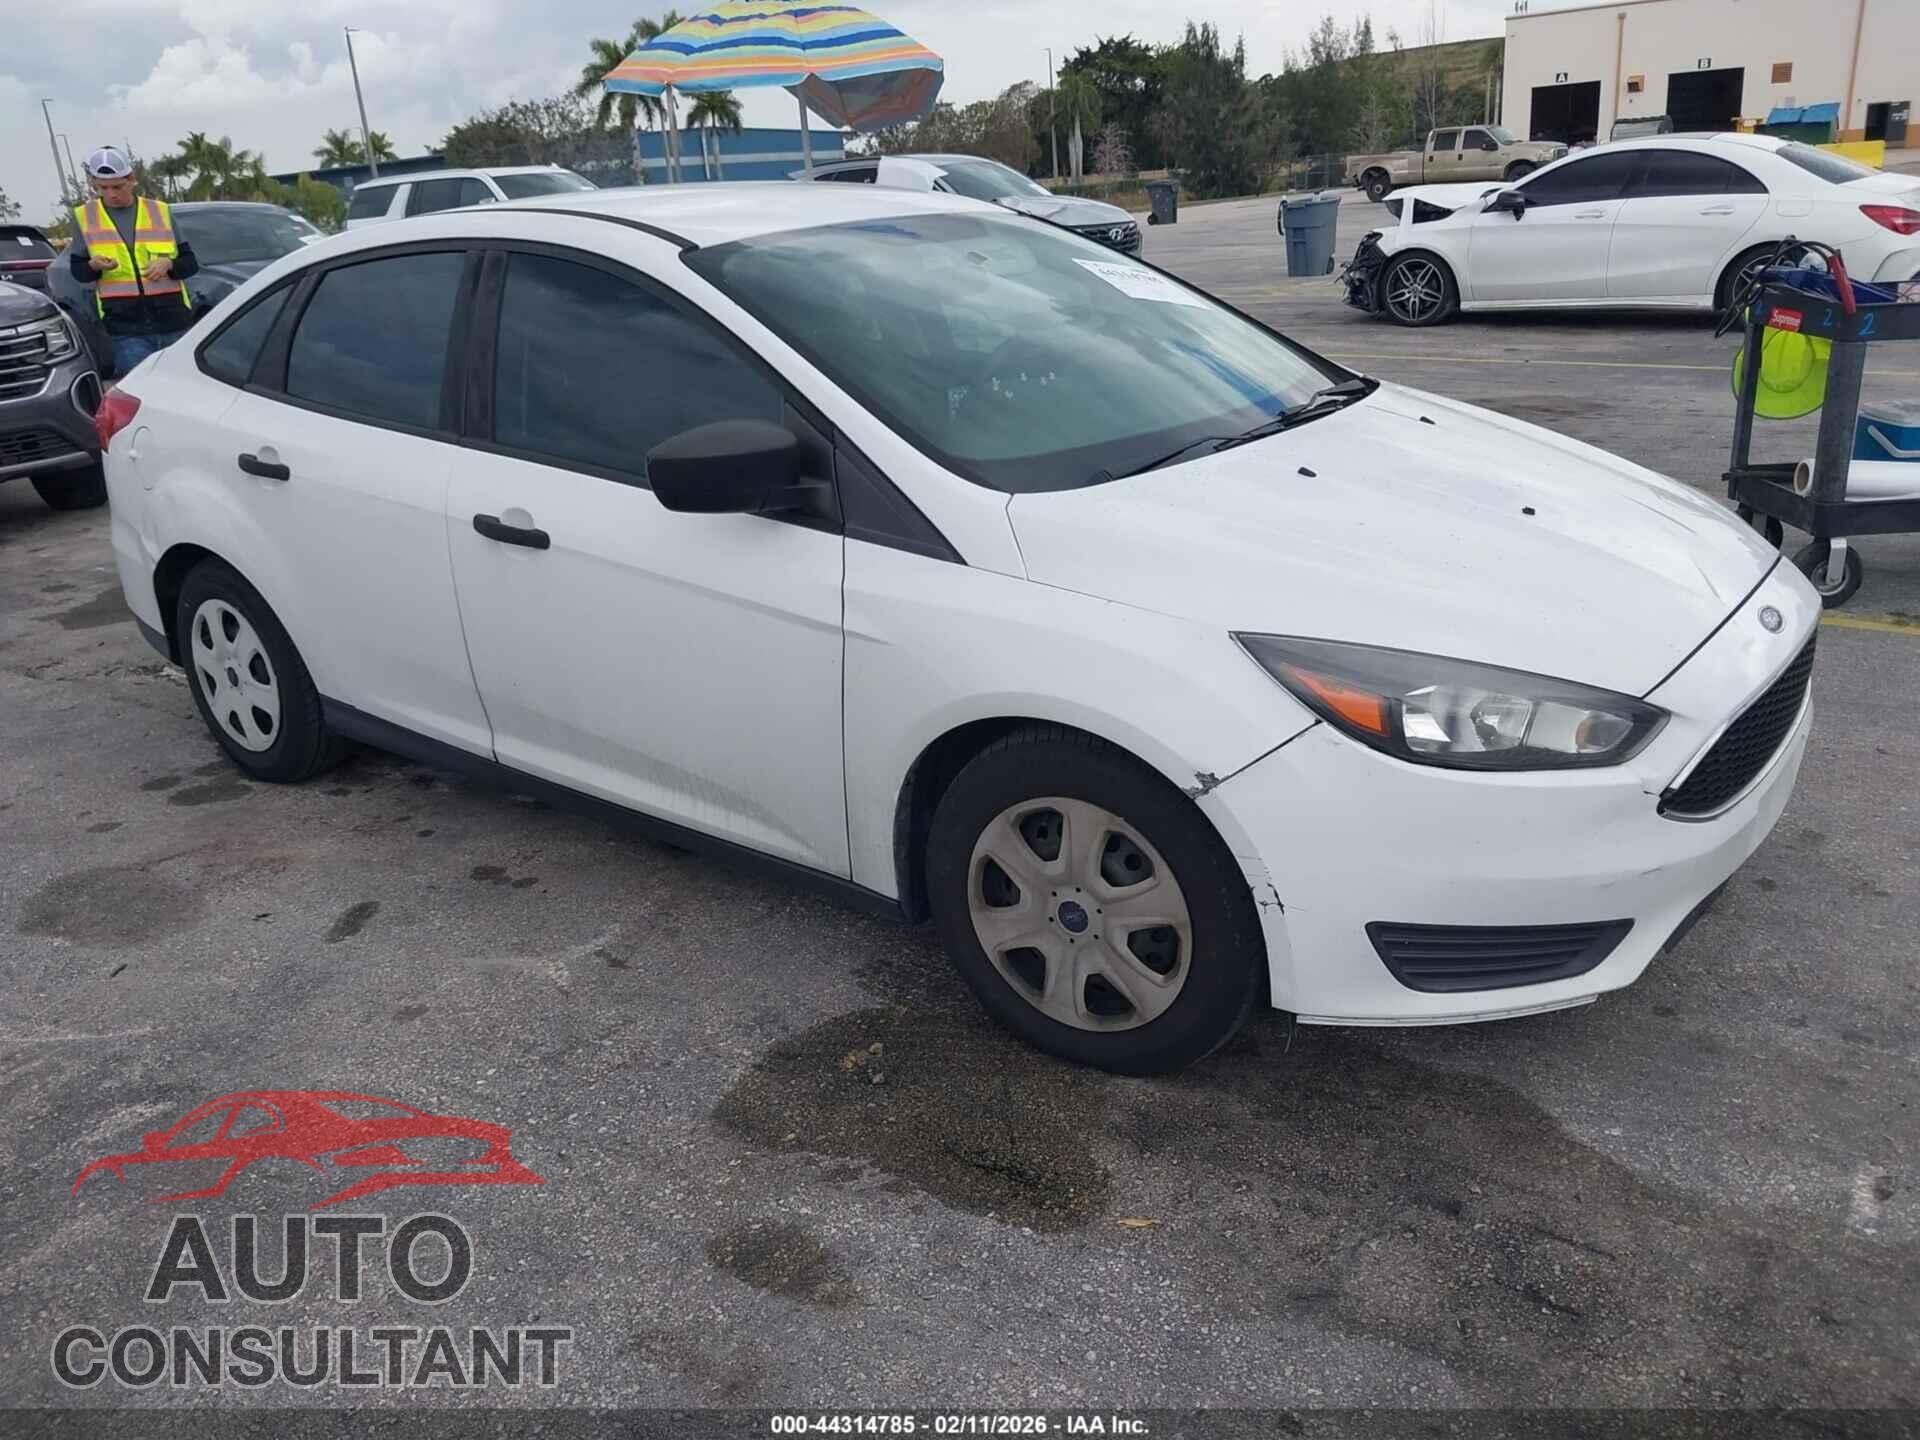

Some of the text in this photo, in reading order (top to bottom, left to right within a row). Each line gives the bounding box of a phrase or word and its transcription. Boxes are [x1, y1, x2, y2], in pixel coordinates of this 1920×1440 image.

[1699, 58, 1710, 69] B
[1557, 73, 1568, 83] A
[1823, 308, 1833, 327] 2
[1858, 312, 1877, 336] 2
